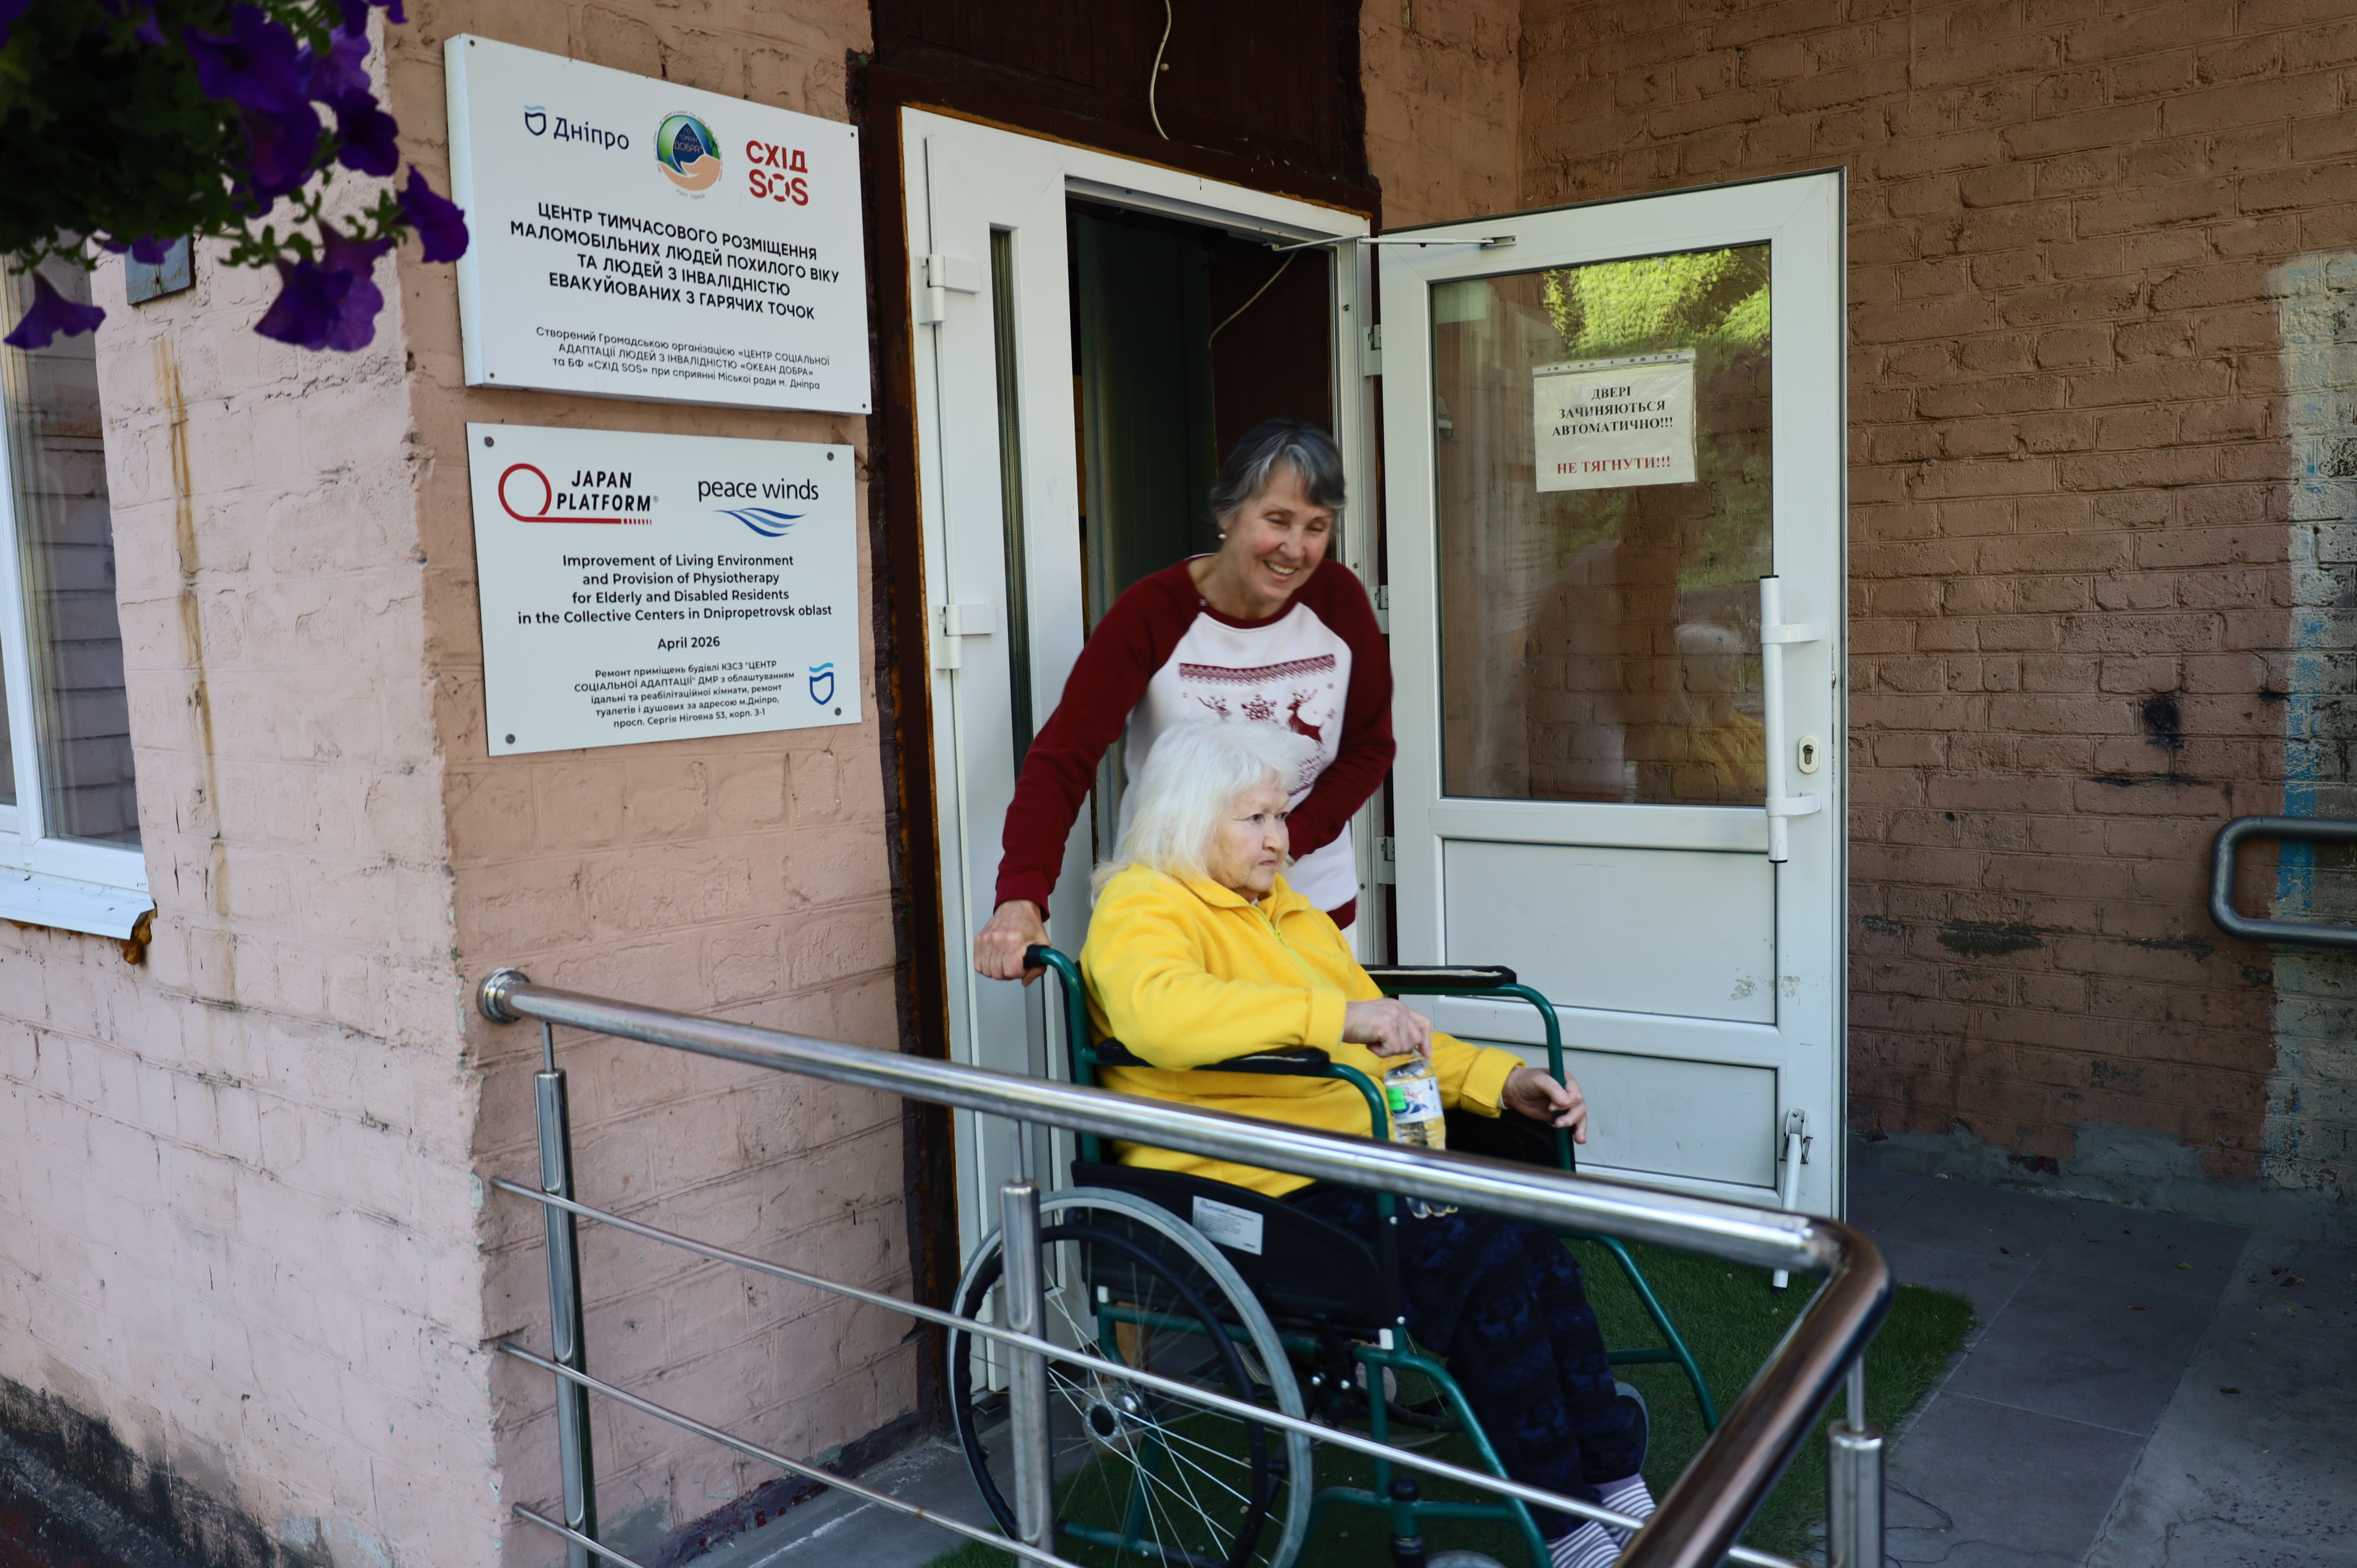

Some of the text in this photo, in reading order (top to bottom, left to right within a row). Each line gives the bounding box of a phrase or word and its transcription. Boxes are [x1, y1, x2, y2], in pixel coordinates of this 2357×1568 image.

[553, 116, 630, 151] Дніпро
[745, 139, 809, 174] СХІД
[748, 168, 809, 207] SOS
[538, 201, 817, 261] ЦЕНТР ТИМЧАСОВОГО РОЗМІЩЕННЯ
[510, 220, 840, 284] МАЛОМОБІЛЬНИХ ЛЮДЕЙ ПОХИЛОГО ВІКУ
[576, 253, 598, 270] ТА
[602, 257, 663, 279] ЛЮДЕЙ
[681, 268, 790, 297] ІНВАЛІДНІСТЮ
[548, 271, 682, 303] ЕВАКУЙОВАНИХ
[699, 292, 764, 314] ГАРЯЧИХ
[767, 301, 815, 320] ТОЧОК
[535, 326, 830, 367] Створений Громадською організацією «ЦЕНТР СОЦІАЛЬНОЇ
[558, 343, 616, 359] АДАПТАЦІЇ
[618, 348, 657, 362] ЛЮДЕЙ
[667, 353, 738, 370] ІНВАЛІДНІСТЮ
[740, 361, 777, 373] «ОКЕАН
[778, 365, 814, 376] ДОБРА»
[552, 357, 565, 367] та
[567, 357, 584, 368] БФ
[587, 360, 620, 373] «СХІД
[621, 363, 648, 374] SOS»
[651, 367, 670, 378] при
[672, 369, 716, 380] сприянні
[717, 372, 751, 384] Міської
[752, 377, 777, 387] ради
[789, 378, 820, 391] Дніпра
[1590, 385, 1631, 400] ДВЕРІ
[1558, 400, 1665, 419] ЗАЧИНЯЮТЬСЯ
[1551, 416, 1673, 437] АВТОМАТИЧНО!!!
[1556, 455, 1670, 475] НЕ ТЯГНУТИ!!!
[571, 470, 632, 489] JAPAN
[697, 478, 819, 503] peace winds
[563, 553, 794, 568] Improvement of Living Environment
[582, 571, 780, 587] and Provision of Physiotherapy
[572, 588, 790, 606] for Elderly and Disabled Residents
[517, 604, 832, 625] in the Collective Centers in Dnipropetrovsk oblast
[657, 636, 721, 653] April 2026
[594, 669, 631, 679] Ремонт
[633, 665, 687, 678] приміщень
[687, 662, 720, 674] будівлі
[573, 679, 638, 693] СОЦІАЛЬНОЇ
[697, 675, 719, 686] ДМР
[726, 672, 795, 683] облаштуванням
[590, 692, 626, 705] їдальні
[640, 688, 711, 703] реабілітаційної
[713, 687, 750, 696] кімнати,
[751, 684, 782, 695] ремонт
[595, 705, 636, 719] туалетів
[637, 704, 641, 714] і
[643, 704, 685, 715] душових
[698, 700, 738, 710] адресою
[739, 695, 780, 706] м.Дніпро,
[613, 719, 645, 730] просп.
[646, 714, 677, 726] Сергія
[679, 713, 714, 723] Нігояна
[715, 710, 728, 720] 53,
[729, 710, 753, 719] корп.
